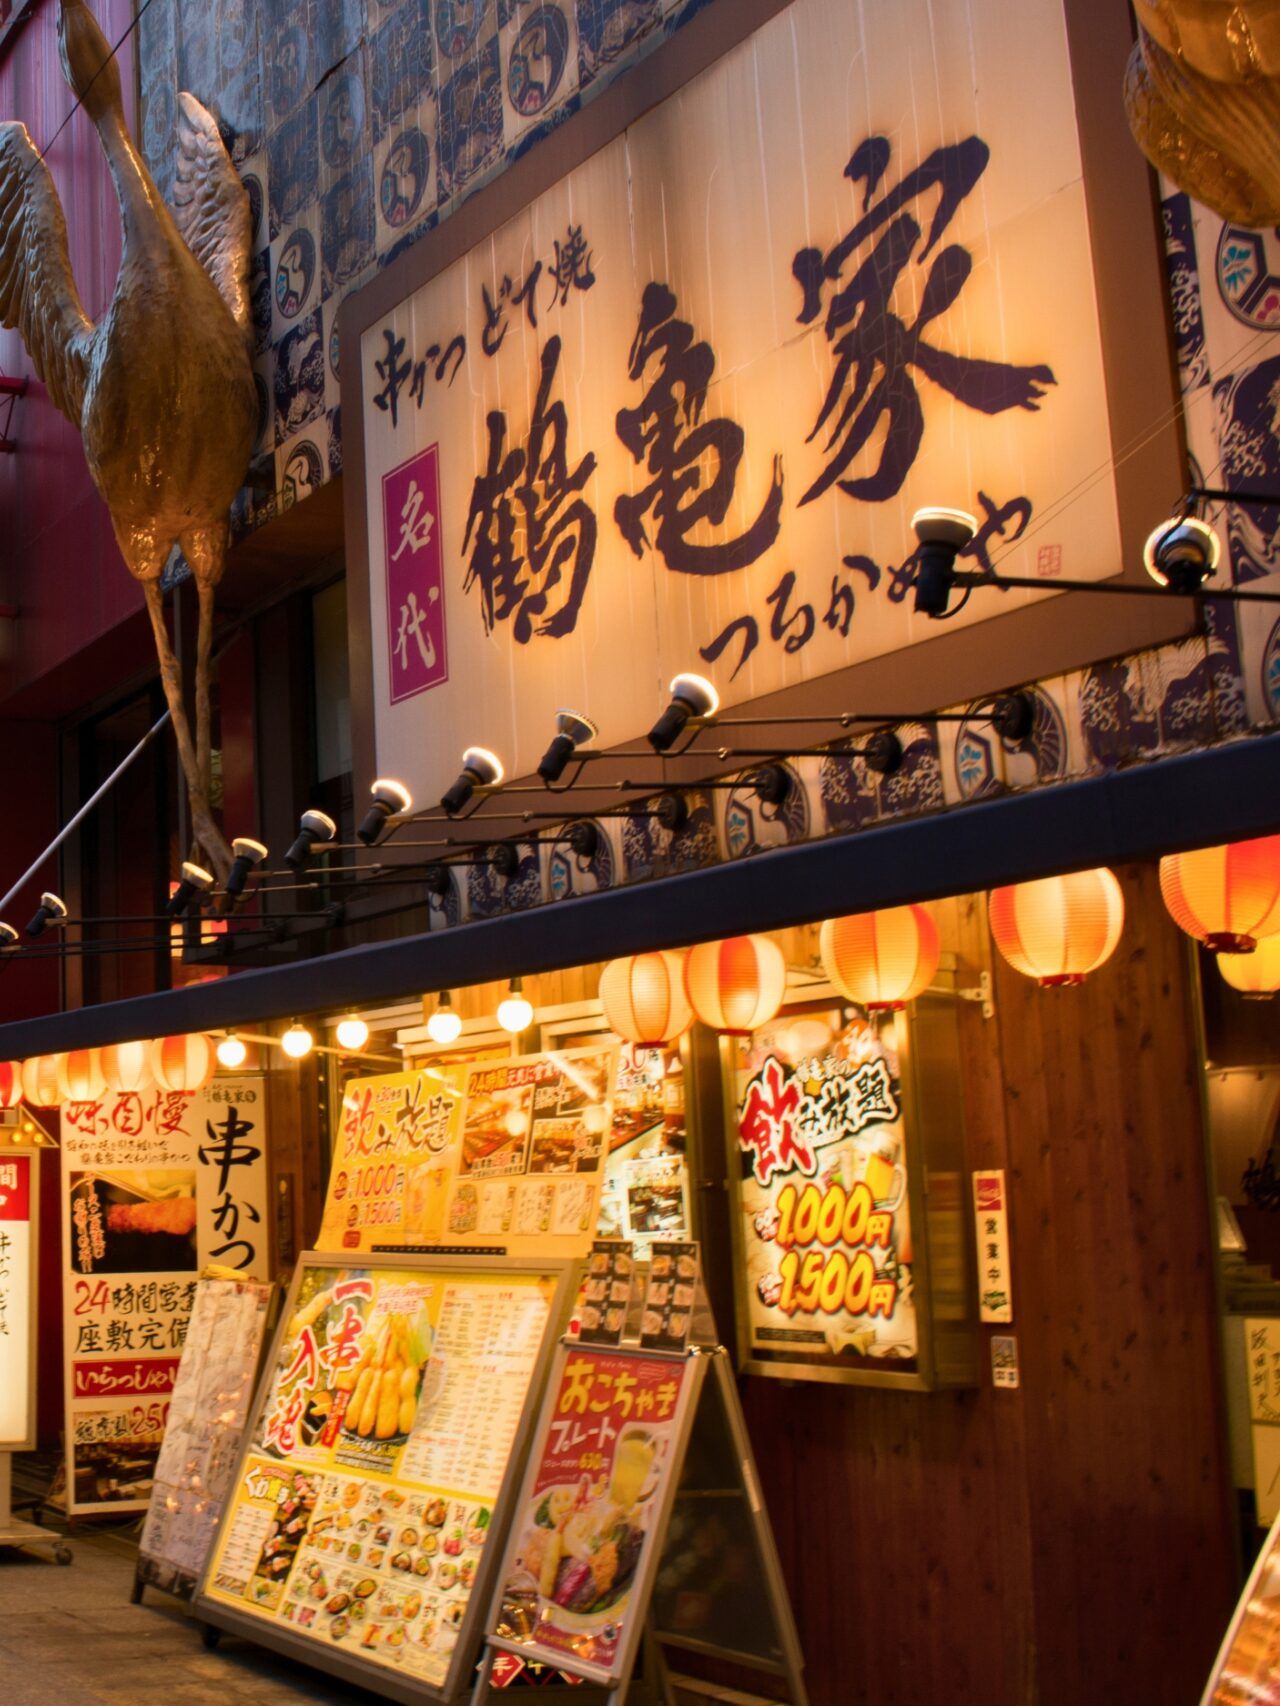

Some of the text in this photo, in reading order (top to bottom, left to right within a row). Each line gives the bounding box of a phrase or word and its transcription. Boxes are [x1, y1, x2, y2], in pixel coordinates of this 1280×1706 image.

[461, 135, 1060, 646] 鶴亀家
[390, 480, 441, 673] 名代
[65, 1090, 193, 1137] 味自慢
[740, 1061, 898, 1182] 飲み放題
[197, 1105, 262, 1270] 串かつ
[984, 1217, 1001, 1281] 営業中
[75, 1317, 191, 1353] 座敷完備
[560, 1359, 677, 1418] おこちゃま
[551, 1416, 617, 1454] プレート
